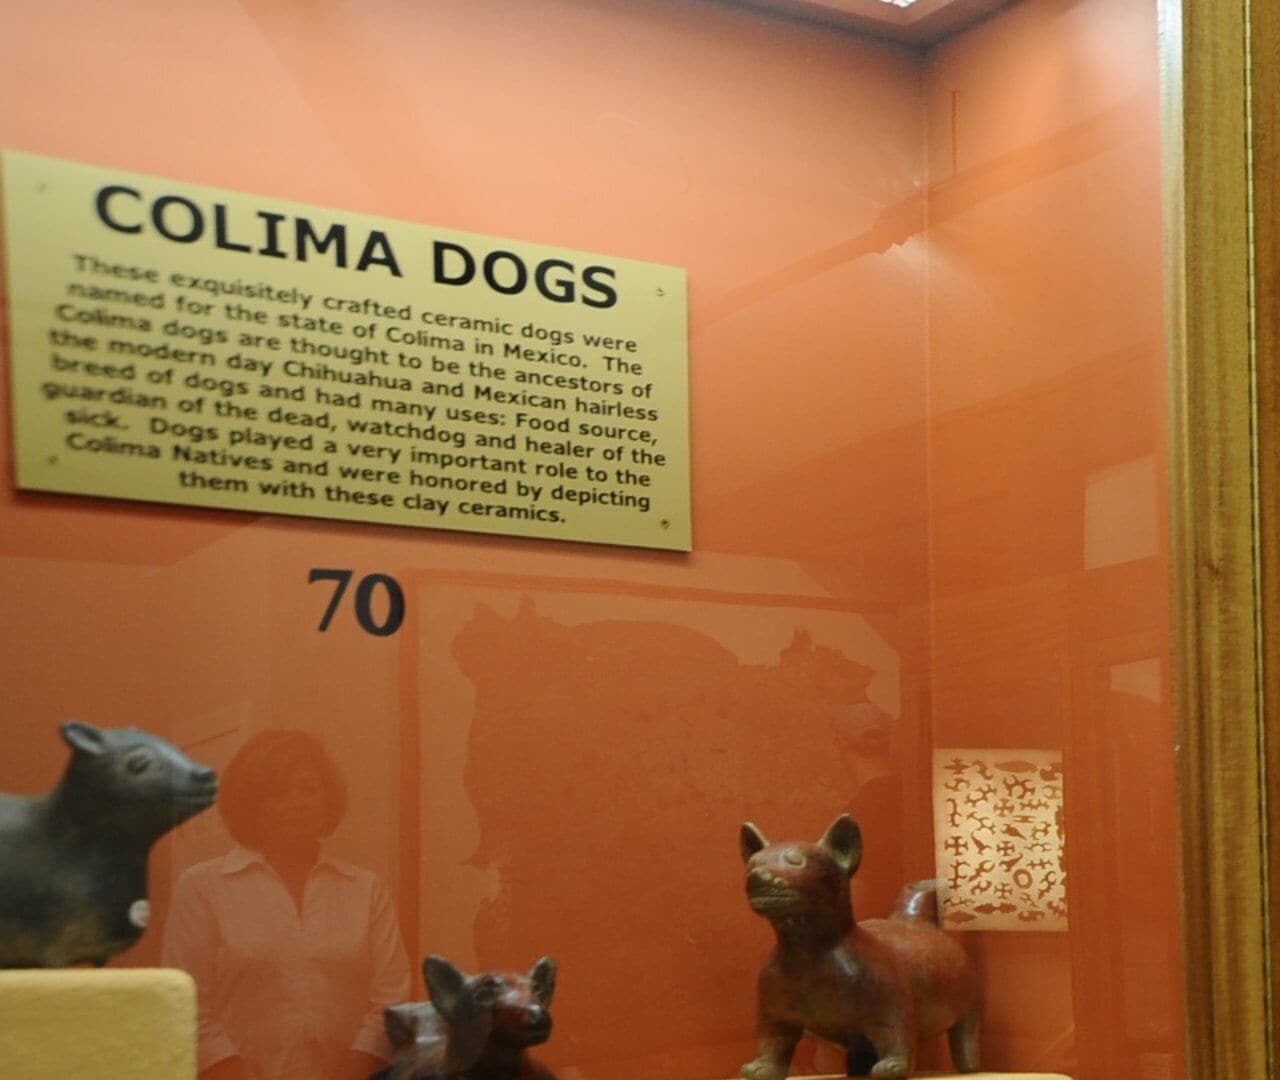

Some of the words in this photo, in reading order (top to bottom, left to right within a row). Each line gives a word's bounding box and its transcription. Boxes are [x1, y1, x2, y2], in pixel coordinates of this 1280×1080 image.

[94, 186, 403, 276] COLIMA
[432, 241, 618, 308] DOGS
[67, 283, 165, 309] named
[175, 295, 214, 315] for
[224, 304, 267, 324] the
[278, 314, 343, 335] state
[352, 323, 376, 339] of
[385, 326, 465, 351] Colima
[474, 338, 493, 355] in
[503, 343, 587, 368] Mexico.
[602, 355, 642, 375] The
[74, 254, 158, 283] These
[170, 274, 313, 309] exquisitely
[323, 297, 411, 320] crafted
[421, 312, 512, 335] ceramic
[520, 323, 574, 346] dogs
[583, 334, 637, 352] were
[48, 330, 97, 350] the
[108, 340, 216, 365] modern
[226, 353, 272, 376] day
[282, 360, 412, 391] Chihuahua
[421, 381, 464, 398] and
[474, 385, 566, 410] Mexican
[575, 397, 658, 421] hairless
[54, 304, 152, 332] Colima
[162, 320, 228, 345] dogs
[238, 333, 280, 350] are
[290, 338, 389, 365] thought
[398, 352, 422, 369] to
[431, 355, 460, 374] be
[468, 361, 506, 380] the
[514, 370, 623, 395] ancestors
[631, 383, 653, 398] of
[40, 382, 167, 408] guardian
[177, 397, 204, 413] of
[214, 401, 258, 421] the
[267, 407, 336, 432] dead,
[347, 420, 466, 448] watchdog
[474, 434, 516, 450] and
[525, 436, 595, 458] healer
[602, 446, 624, 461] of
[631, 448, 666, 466] the
[51, 354, 136, 380] breed
[146, 368, 173, 384] of
[184, 373, 249, 397] dogs
[258, 384, 305, 402] and
[315, 387, 361, 408] had
[371, 399, 436, 421] many
[446, 408, 505, 425] uses:
[515, 412, 570, 433] Food
[578, 423, 657, 446] source,
[64, 410, 128, 429] sick.
[149, 417, 219, 443] Dogs
[229, 428, 313, 451] played
[323, 440, 337, 453] a
[347, 443, 401, 464] very
[410, 447, 527, 474] important
[535, 462, 578, 479] role
[585, 466, 608, 482] to
[615, 469, 650, 487] the
[65, 432, 161, 458] Colima
[172, 444, 273, 470] Natives
[282, 460, 328, 476] and
[338, 466, 400, 484] were
[409, 470, 507, 494] honored
[516, 480, 542, 501] by
[550, 485, 650, 512] depicting
[178, 471, 248, 492] them
[258, 480, 315, 498] with
[324, 486, 394, 507] these
[402, 493, 449, 516] clay
[457, 502, 566, 523] ceramics.
[308, 568, 405, 637] 70
